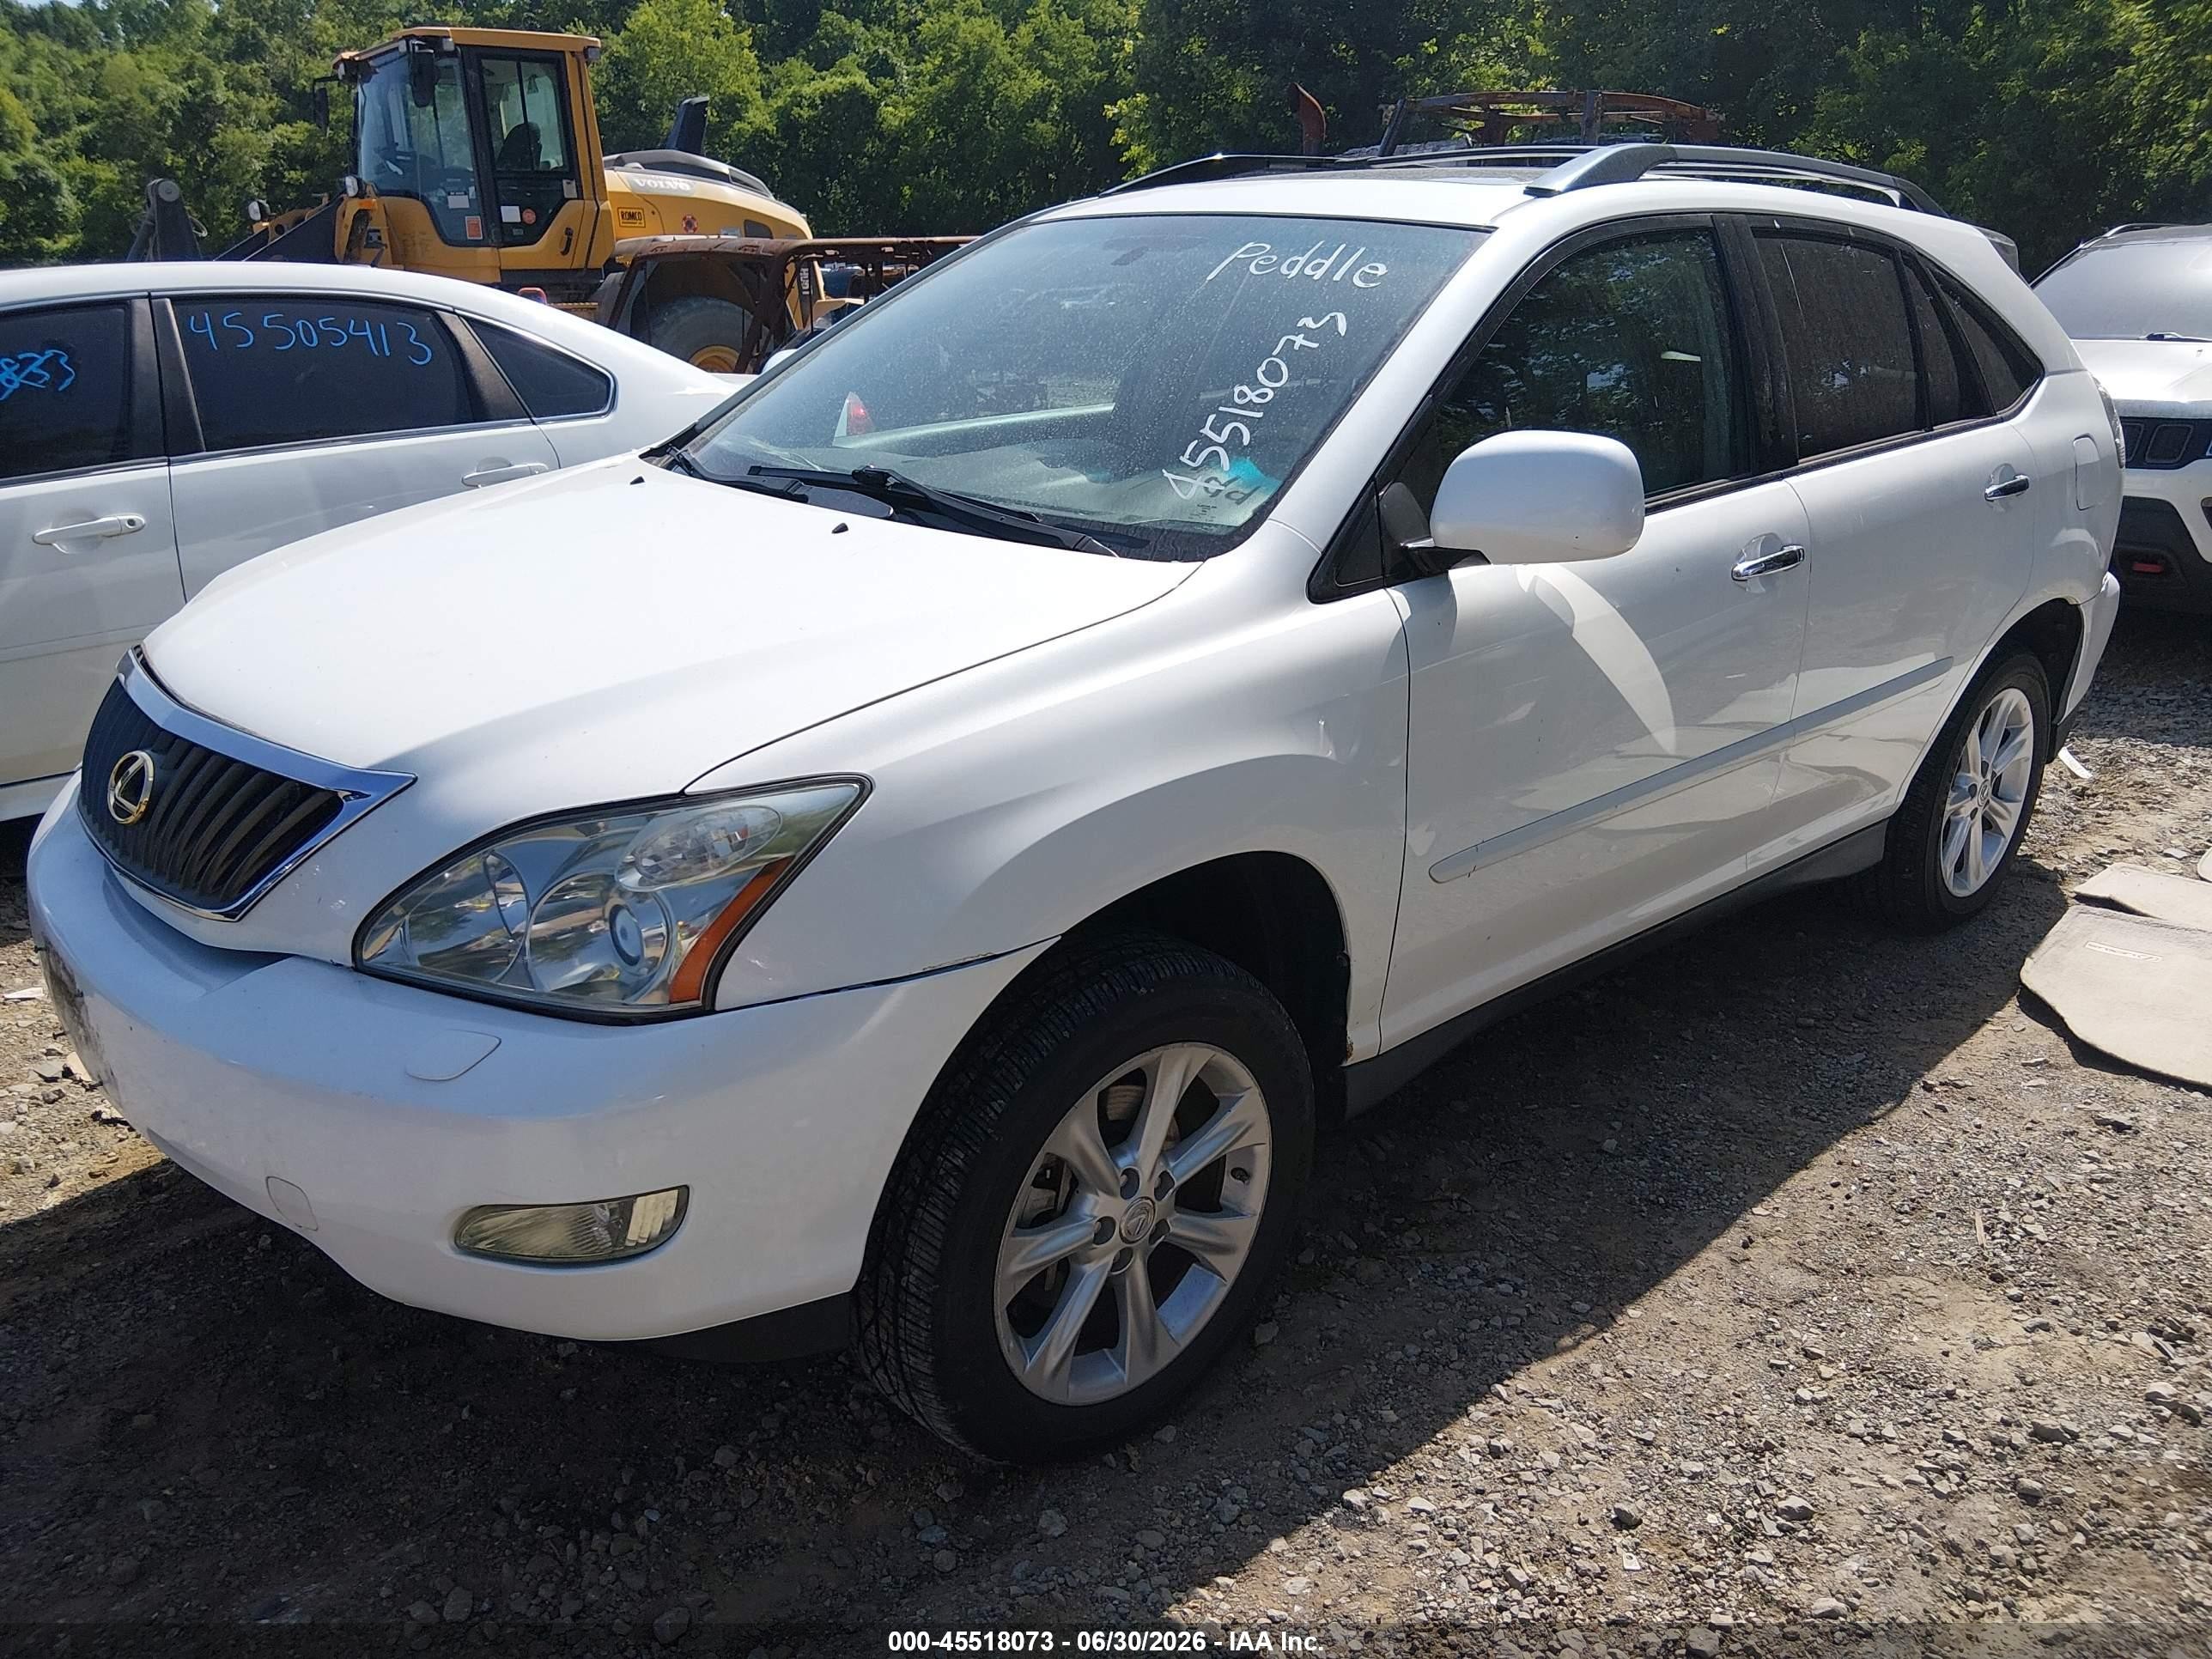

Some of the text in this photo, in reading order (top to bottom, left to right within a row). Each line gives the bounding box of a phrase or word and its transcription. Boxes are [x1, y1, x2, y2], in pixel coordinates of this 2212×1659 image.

[633, 178, 691, 191] VOLVO
[1206, 240, 1389, 289] Peddle
[1162, 312, 1347, 500] 45518073
